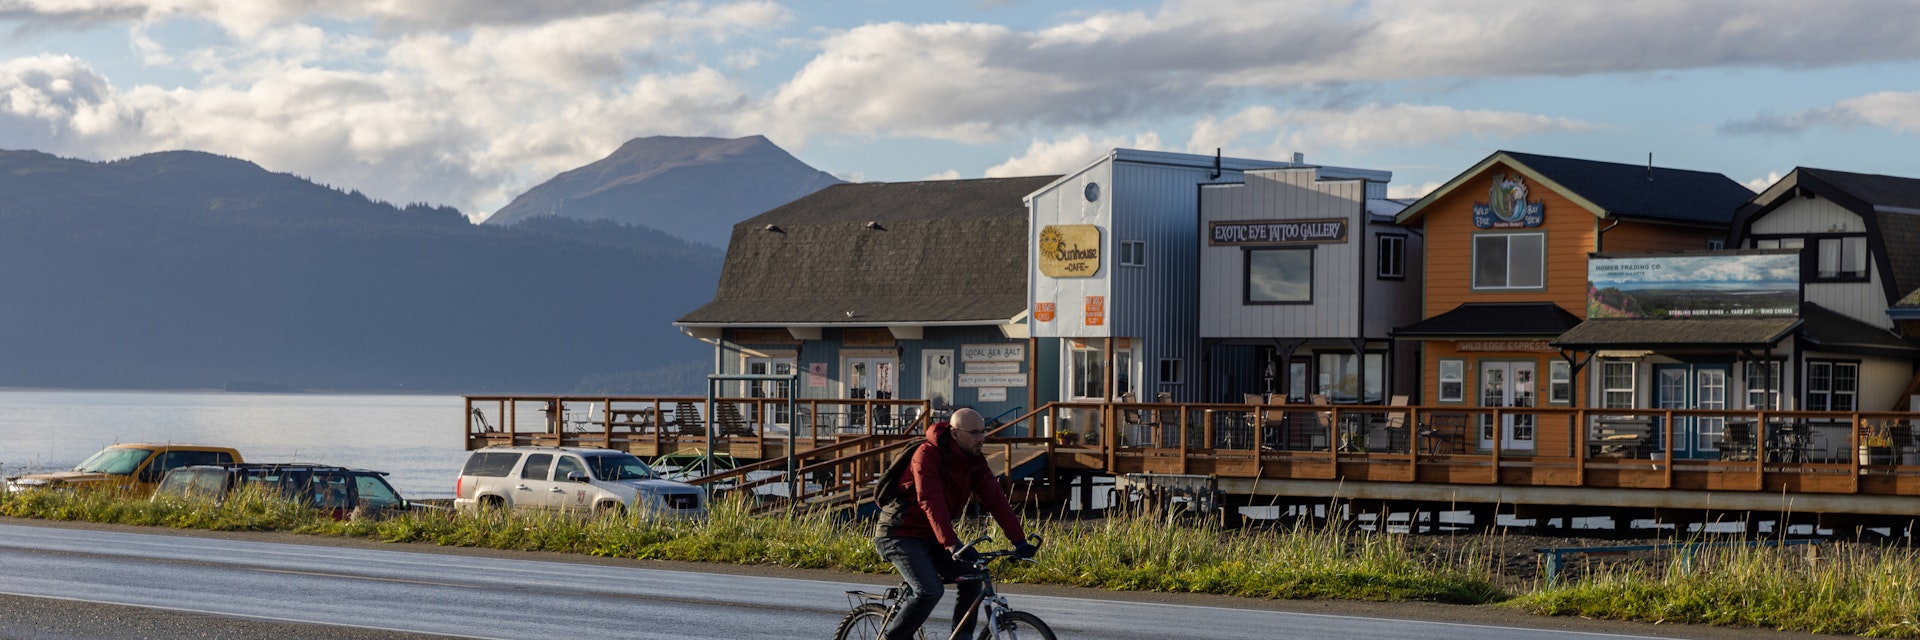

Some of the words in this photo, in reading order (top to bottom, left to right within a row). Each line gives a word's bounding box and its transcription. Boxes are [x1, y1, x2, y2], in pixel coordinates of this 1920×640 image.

[1215, 225, 1247, 242] EXOTIC
[1249, 225, 1267, 240] EYE
[1268, 224, 1299, 242] TATTOO
[1300, 222, 1341, 240] GALLERY
[1056, 241, 1098, 261] Sunhouse
[1462, 341, 1480, 350] WILD
[1483, 341, 1504, 350] EDGE
[965, 348, 985, 359] LOCAL
[988, 348, 1001, 359] SEA
[1004, 348, 1021, 358] SALT
